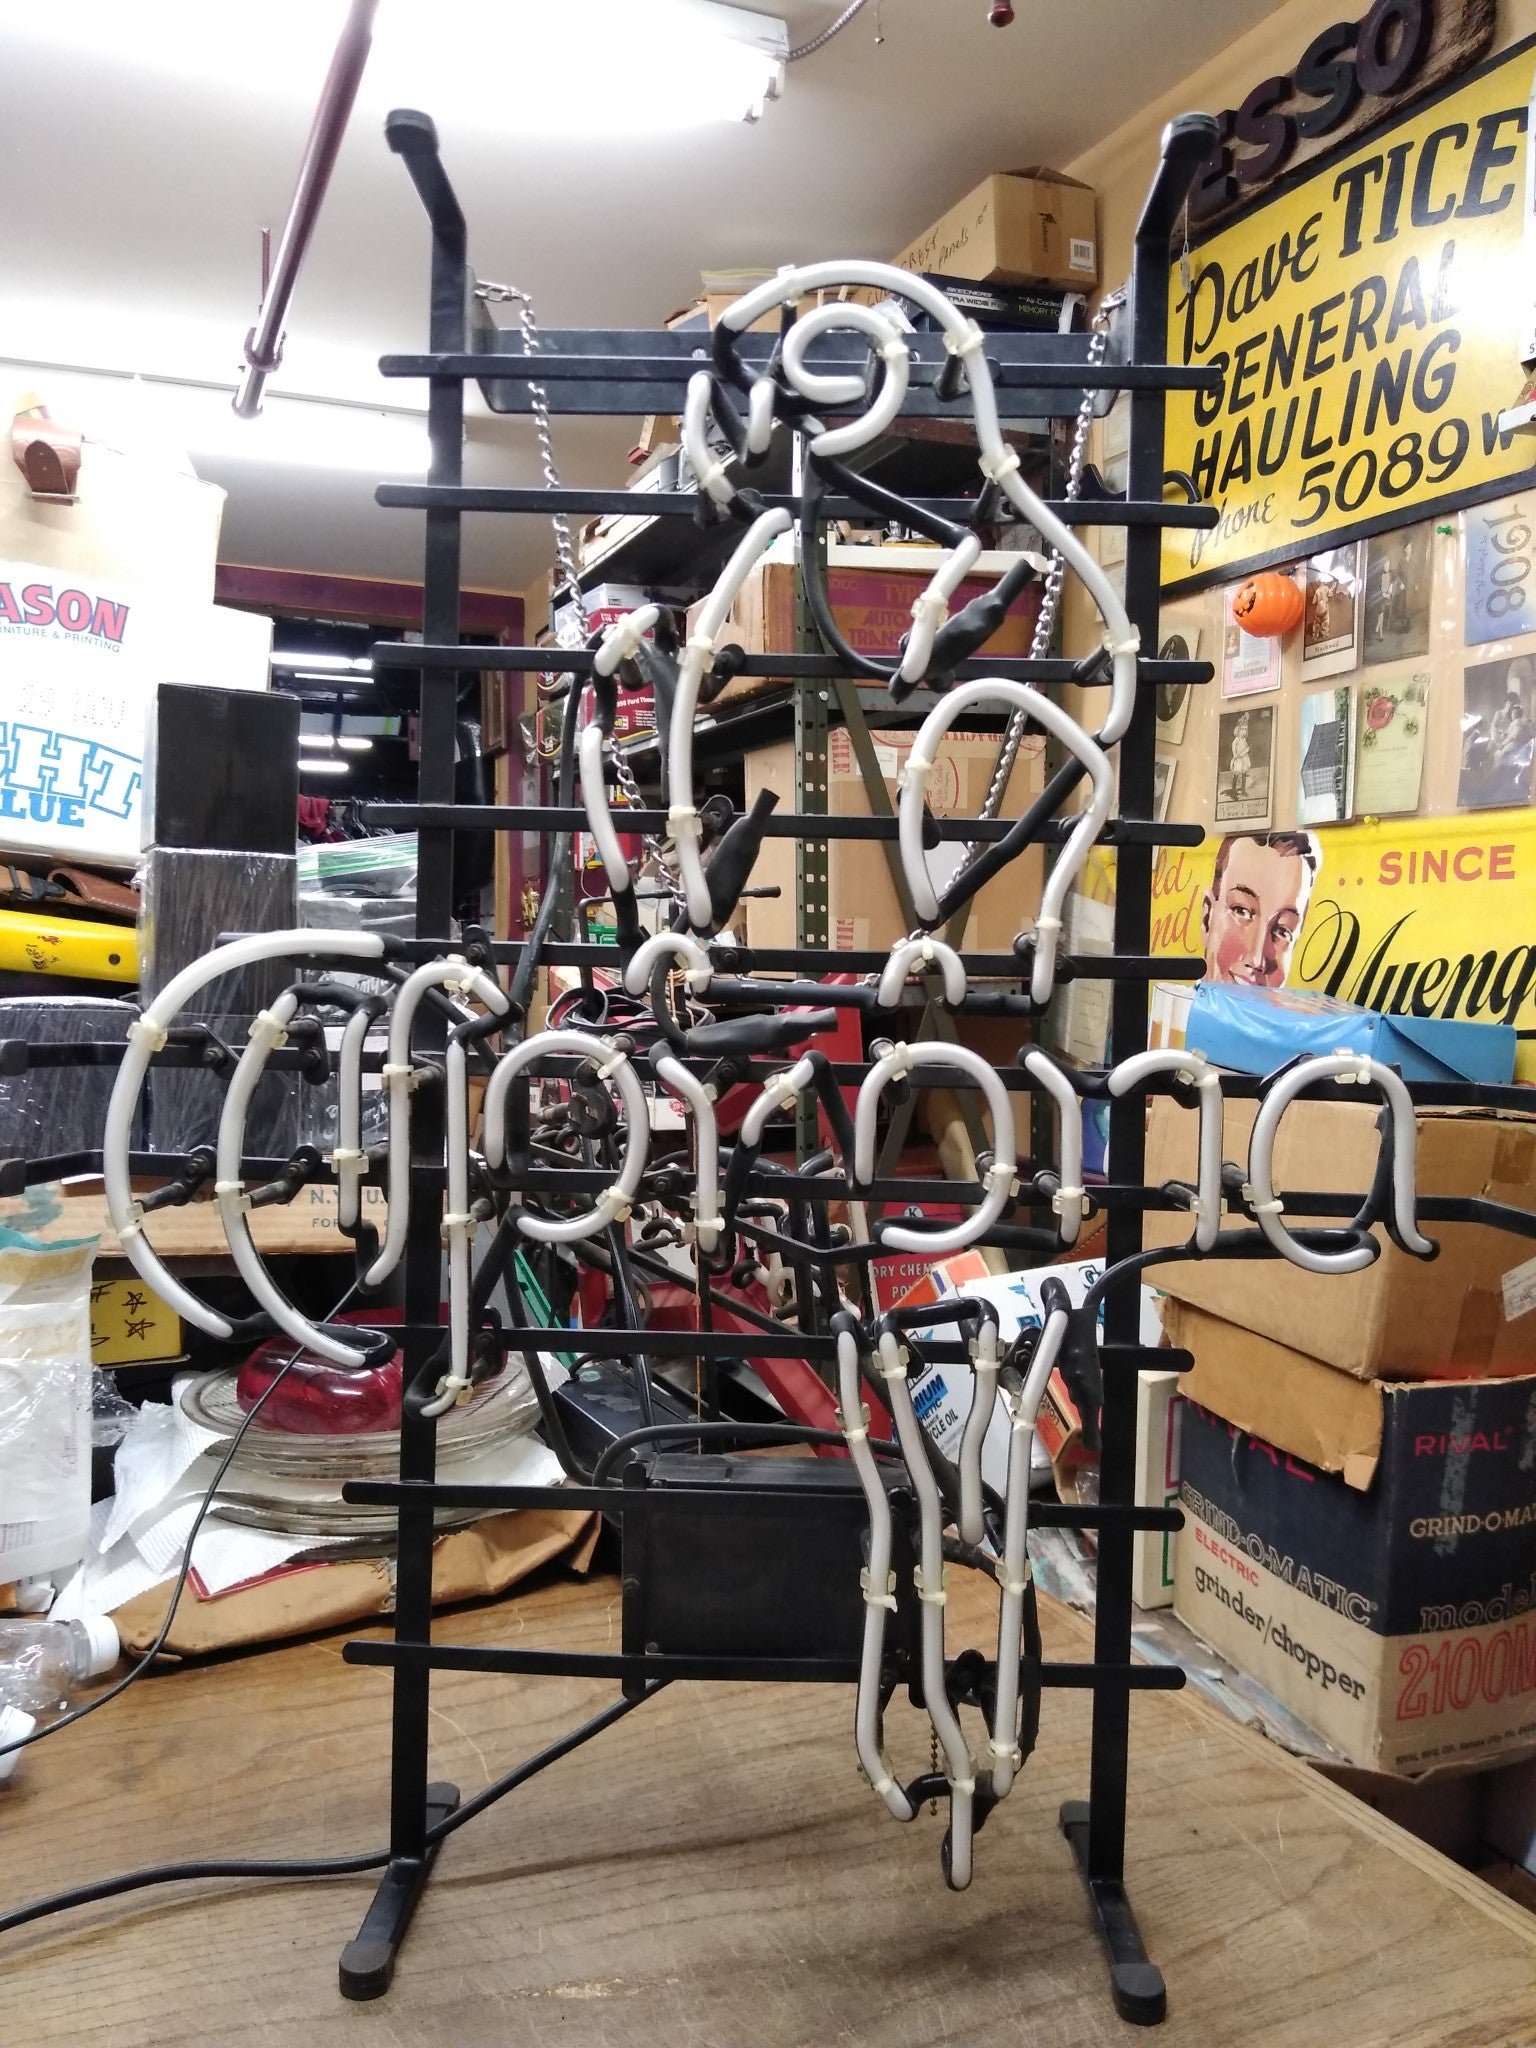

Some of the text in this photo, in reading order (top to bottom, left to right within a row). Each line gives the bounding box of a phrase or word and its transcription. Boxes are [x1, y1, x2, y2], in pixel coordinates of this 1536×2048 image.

[1176, 107, 1529, 366] Dave TICE
[966, 298, 990, 307] WIDE
[1018, 303, 1048, 316] MEMORY
[1193, 240, 1461, 428] GENERAL
[1190, 328, 1462, 504] HAULING
[1291, 418, 1468, 528] 5089
[1482, 503, 1532, 619] 1908
[64, 631, 121, 654] PRINTING
[1378, 844, 1515, 886] SINCE
[873, 1264, 895, 1278] DRY
[946, 1408, 960, 1427] OIL
[1414, 1432, 1508, 1457] RIVAL
[1194, 1527, 1260, 1589] ELECTRIC
[1194, 1565, 1367, 1701] grinder/chopper
